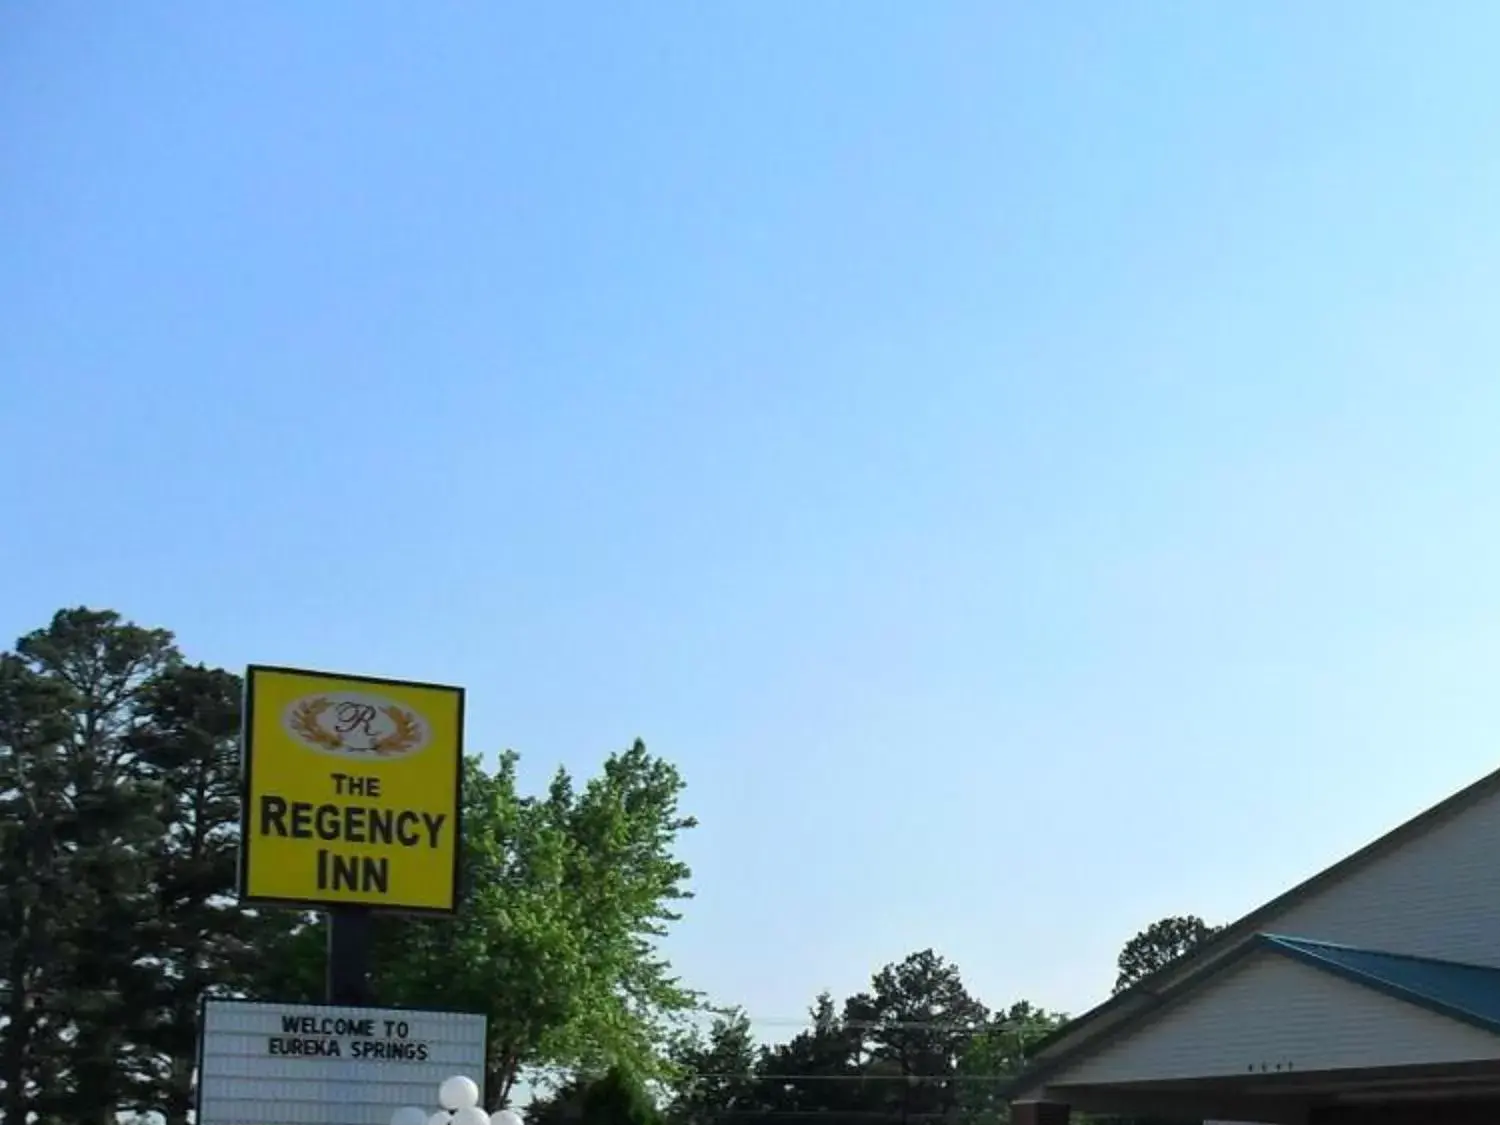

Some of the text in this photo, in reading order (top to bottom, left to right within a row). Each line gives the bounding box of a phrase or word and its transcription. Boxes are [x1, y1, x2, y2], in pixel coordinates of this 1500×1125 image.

[331, 773, 381, 797] THE
[260, 795, 447, 848] REGENCY
[317, 849, 388, 893] INN
[282, 1015, 409, 1038] WELCOME TO
[269, 1038, 428, 1061] EUREKA SPRINGS
